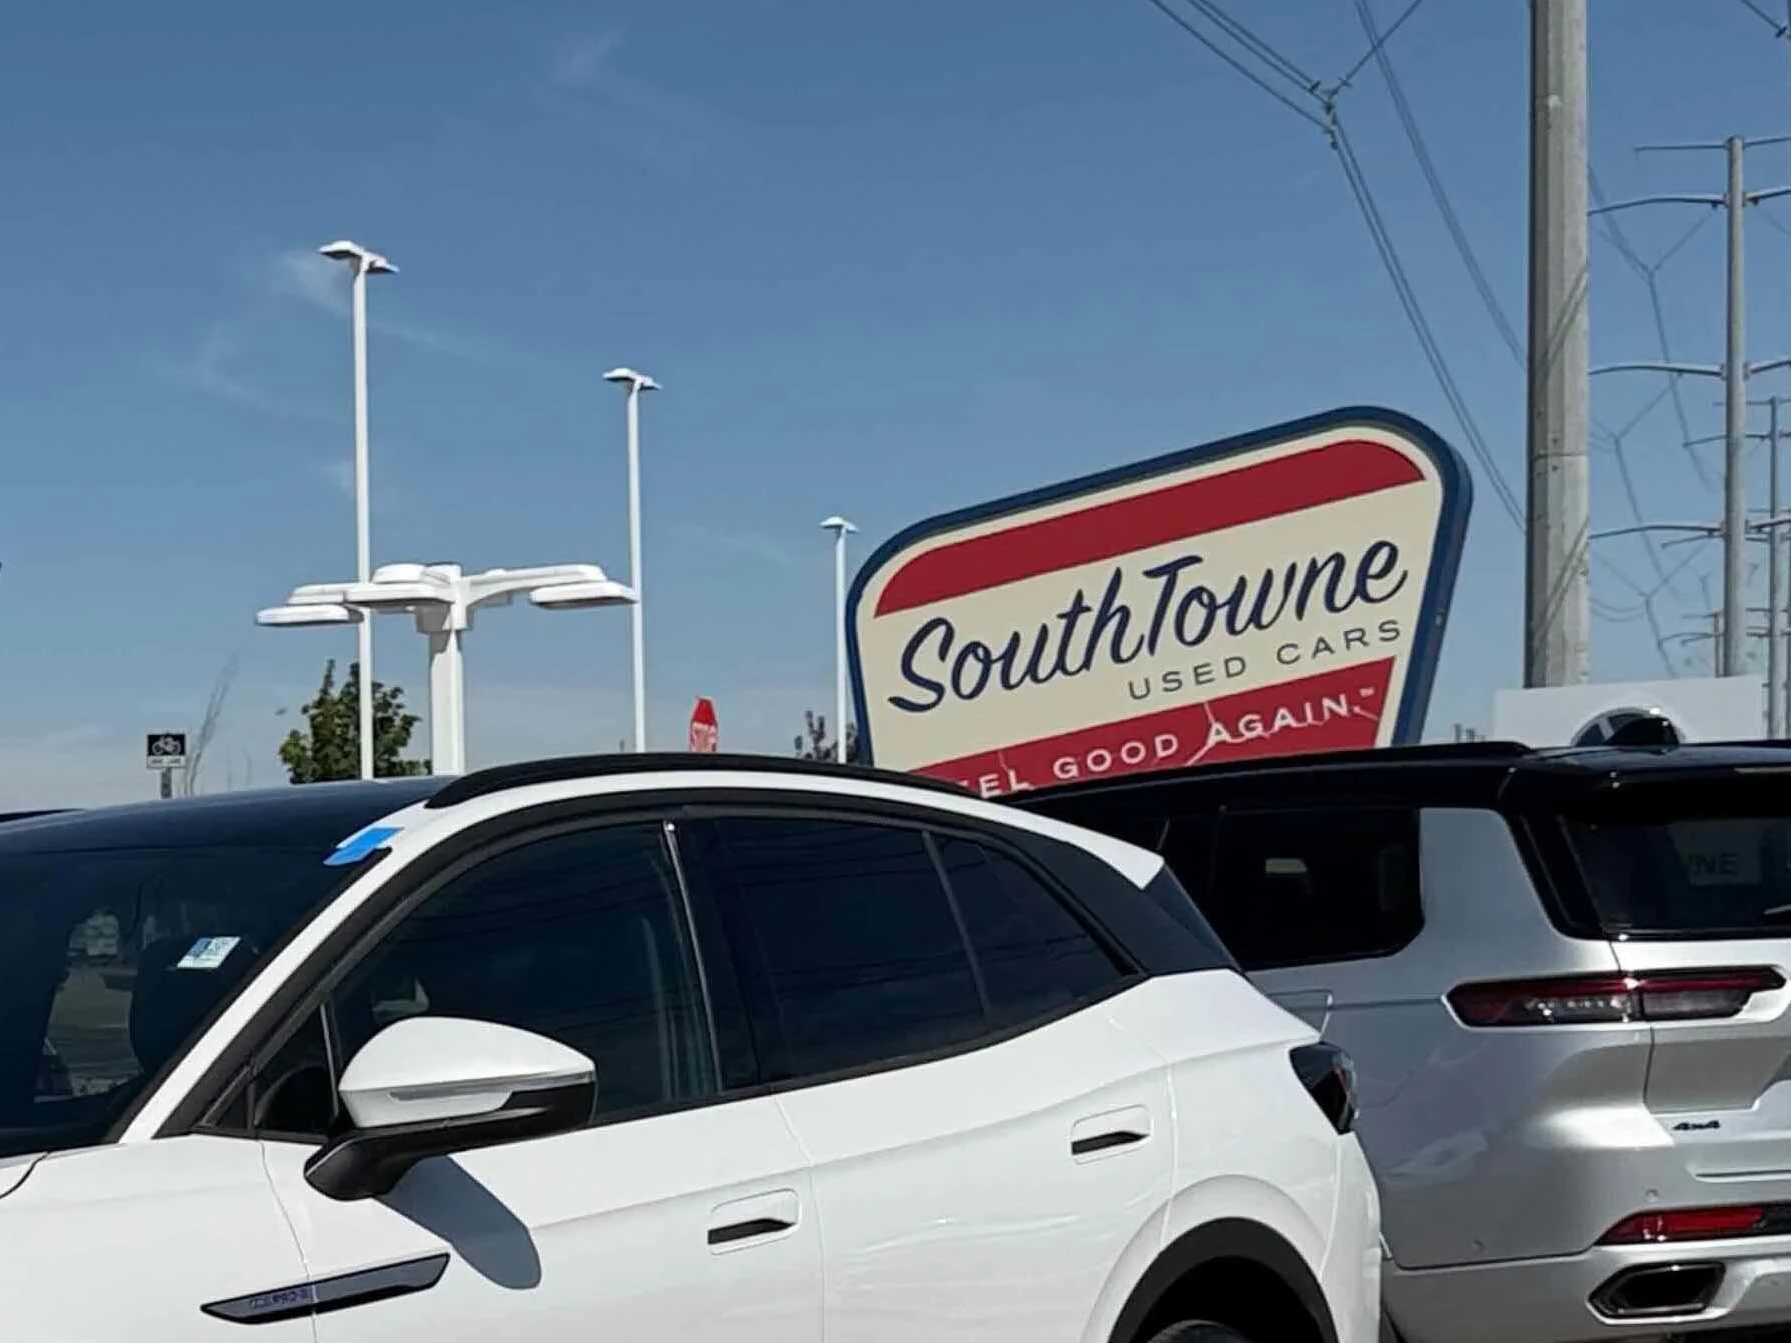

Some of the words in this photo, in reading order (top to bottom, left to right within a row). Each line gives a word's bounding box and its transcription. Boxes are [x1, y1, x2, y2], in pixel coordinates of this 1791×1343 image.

[888, 539, 1407, 713] SouthTowne
[1128, 656, 1247, 700] USED
[1276, 618, 1402, 667] CARS
[1053, 732, 1179, 782] GOOD
